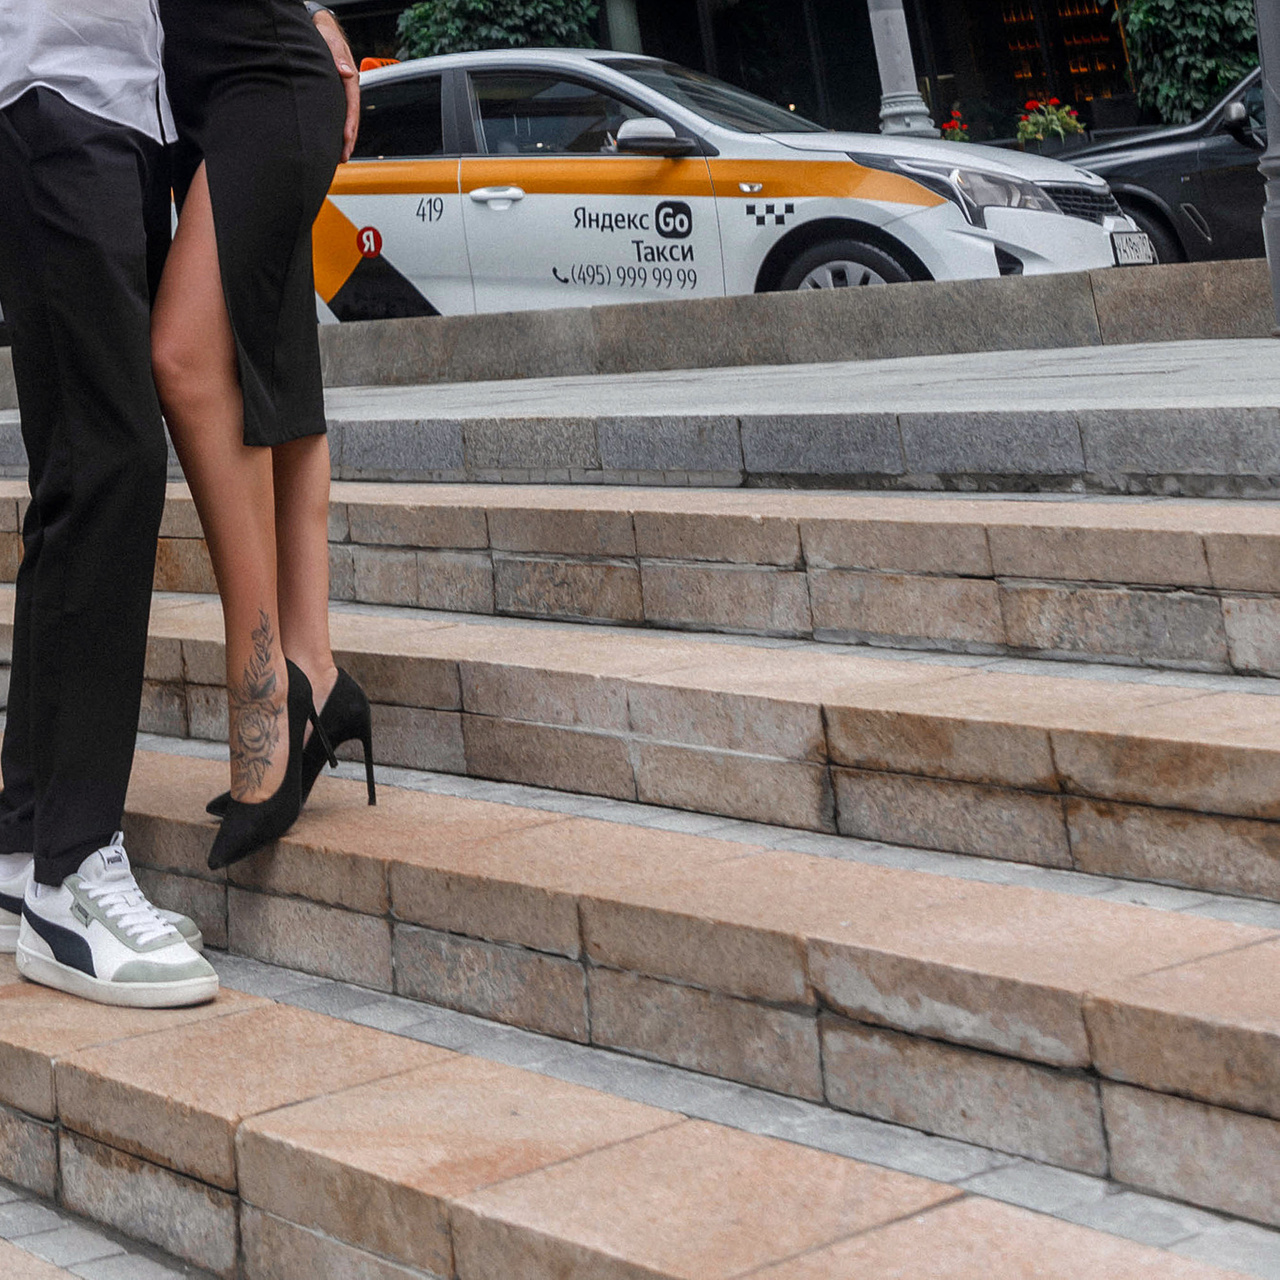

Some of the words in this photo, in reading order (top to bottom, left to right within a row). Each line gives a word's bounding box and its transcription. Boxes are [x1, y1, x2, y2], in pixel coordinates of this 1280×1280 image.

[416, 197, 444, 222] 419
[573, 206, 650, 233] Яндекс
[658, 206, 690, 233] Go
[362, 230, 376, 253] Я
[631, 240, 695, 263] Такси
[571, 263, 612, 286] (495)
[616, 265, 648, 288] 999
[652, 266, 674, 290] 99
[676, 267, 698, 290] 99
